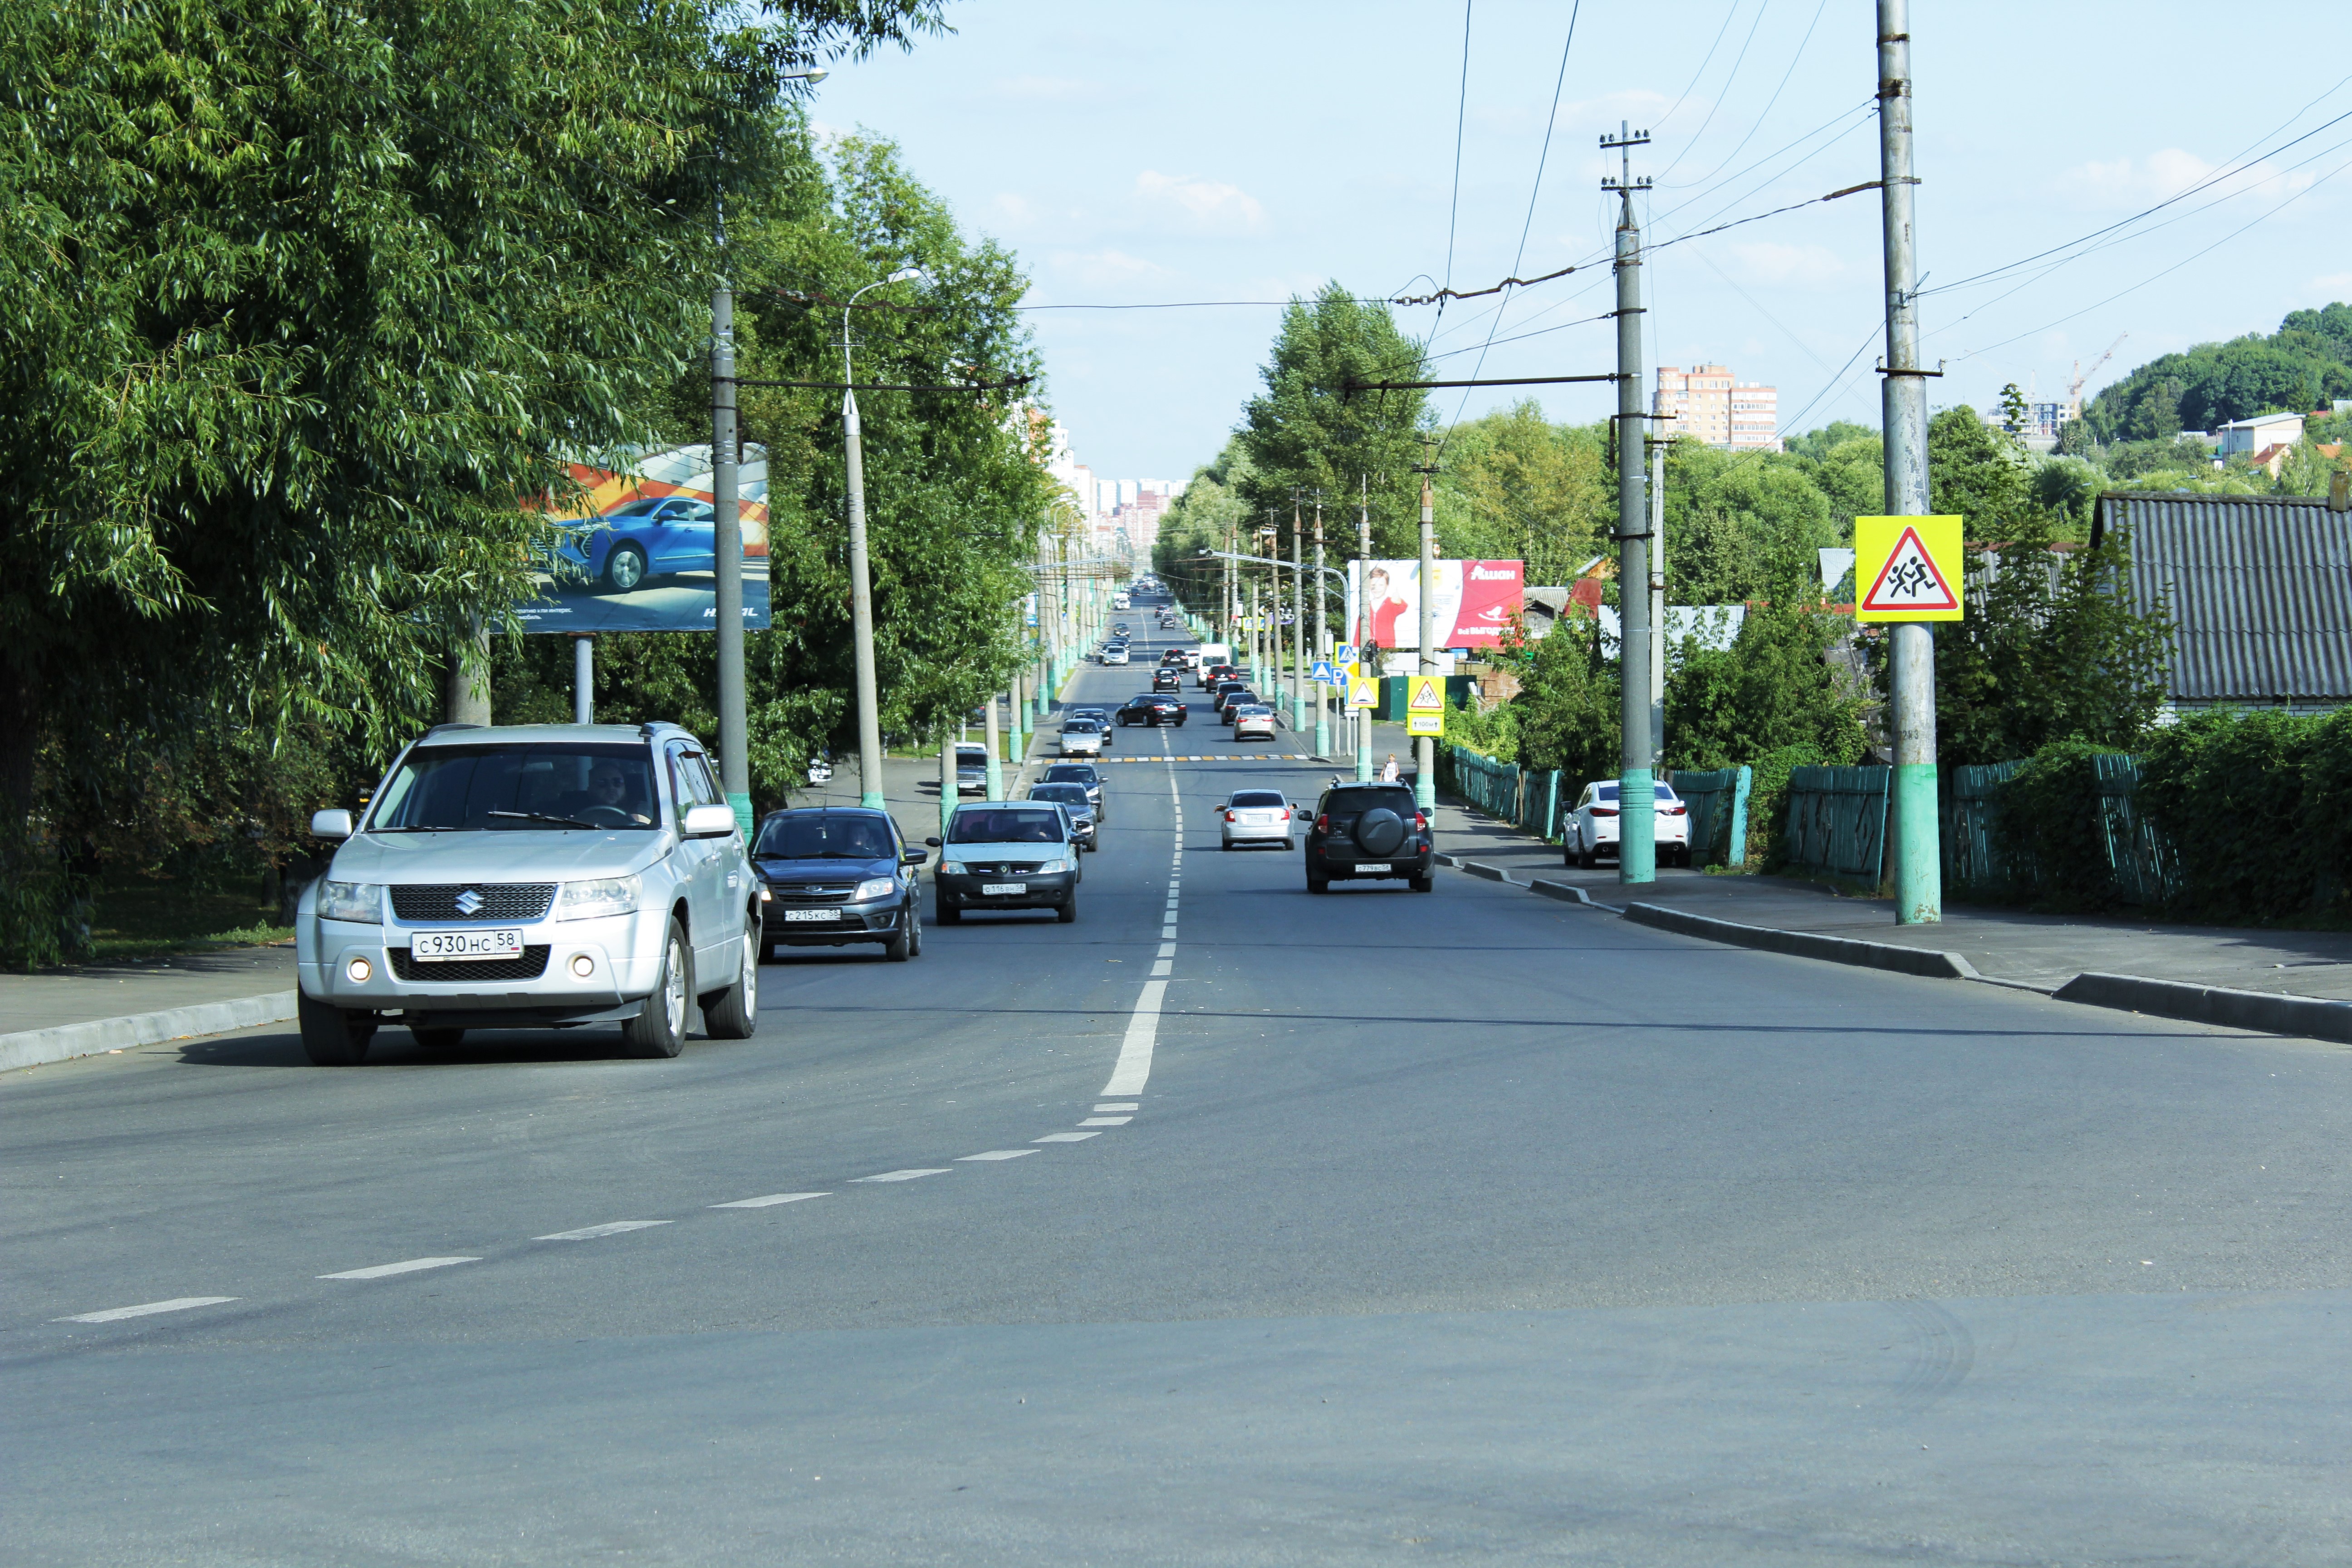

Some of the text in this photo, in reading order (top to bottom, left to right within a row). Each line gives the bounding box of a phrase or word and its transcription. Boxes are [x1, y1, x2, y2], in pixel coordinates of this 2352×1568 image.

[1471, 565, 1515, 580] Ашан
[703, 608, 759, 617] HAL
[789, 911, 826, 920] С215КС
[420, 932, 514, 953] С930НС 58
